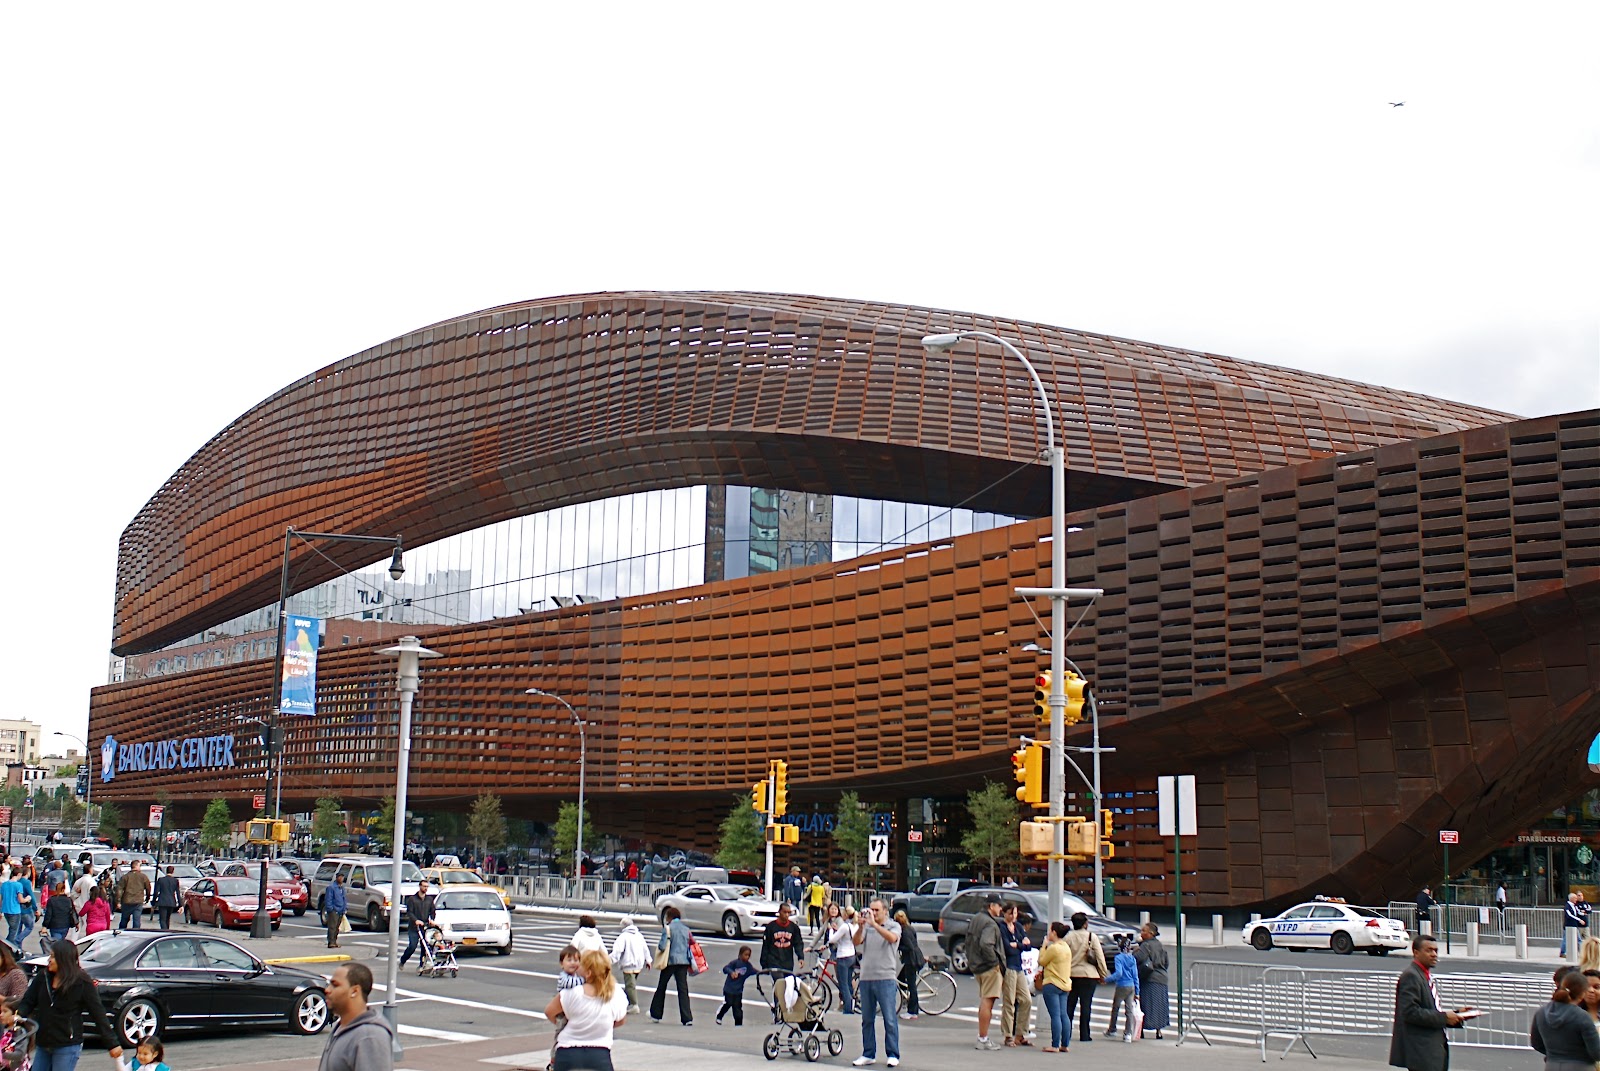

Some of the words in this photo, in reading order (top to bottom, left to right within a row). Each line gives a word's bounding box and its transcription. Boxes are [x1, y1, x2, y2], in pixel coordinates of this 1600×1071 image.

[294, 619, 311, 628] NYC
[290, 668, 303, 676] Like
[118, 739, 179, 771] BARCLAYS
[180, 735, 234, 769] CENTER
[773, 813, 834, 833] ARCLAYS
[1517, 835, 1556, 843] STARBUCKS
[922, 846, 933, 854] VIP
[934, 846, 967, 854] ENTRANC
[1275, 923, 1298, 932] NYPD
